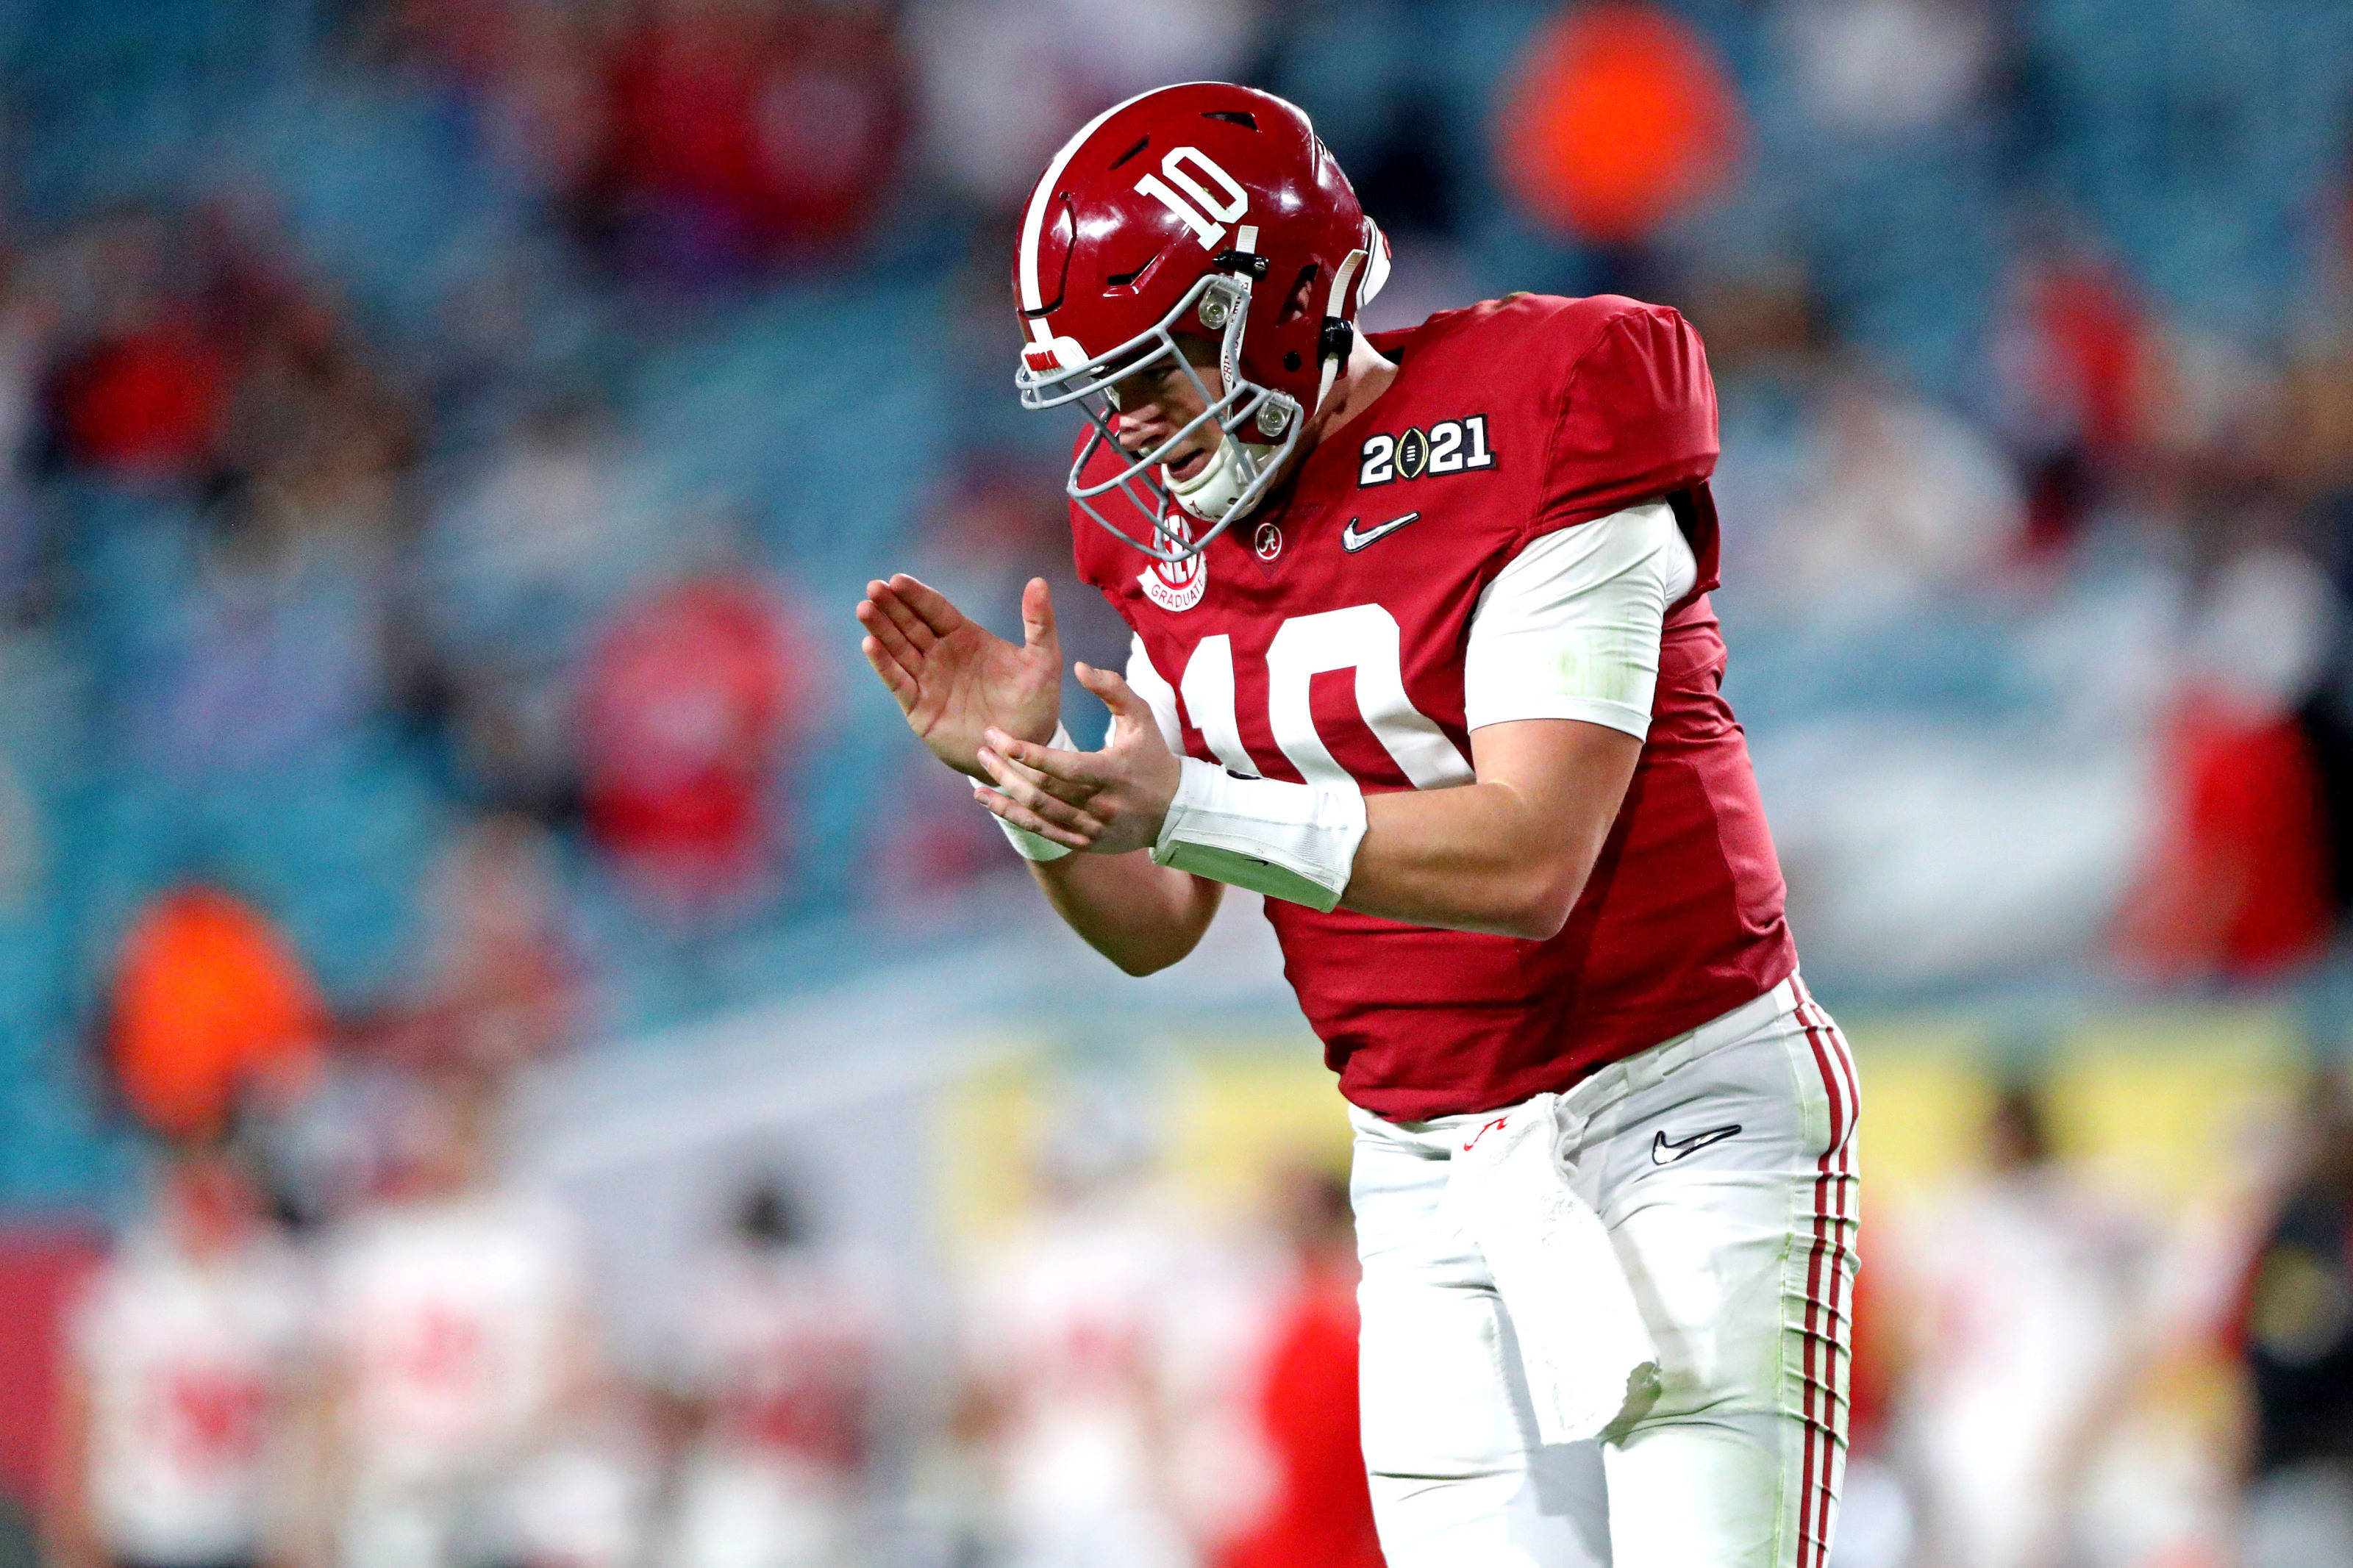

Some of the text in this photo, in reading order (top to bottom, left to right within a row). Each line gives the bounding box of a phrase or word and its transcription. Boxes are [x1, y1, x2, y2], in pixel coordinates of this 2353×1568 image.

[1135, 146, 1249, 251] 10
[1151, 574, 1204, 609] GRADUATE
[1179, 603, 1477, 791] 10
